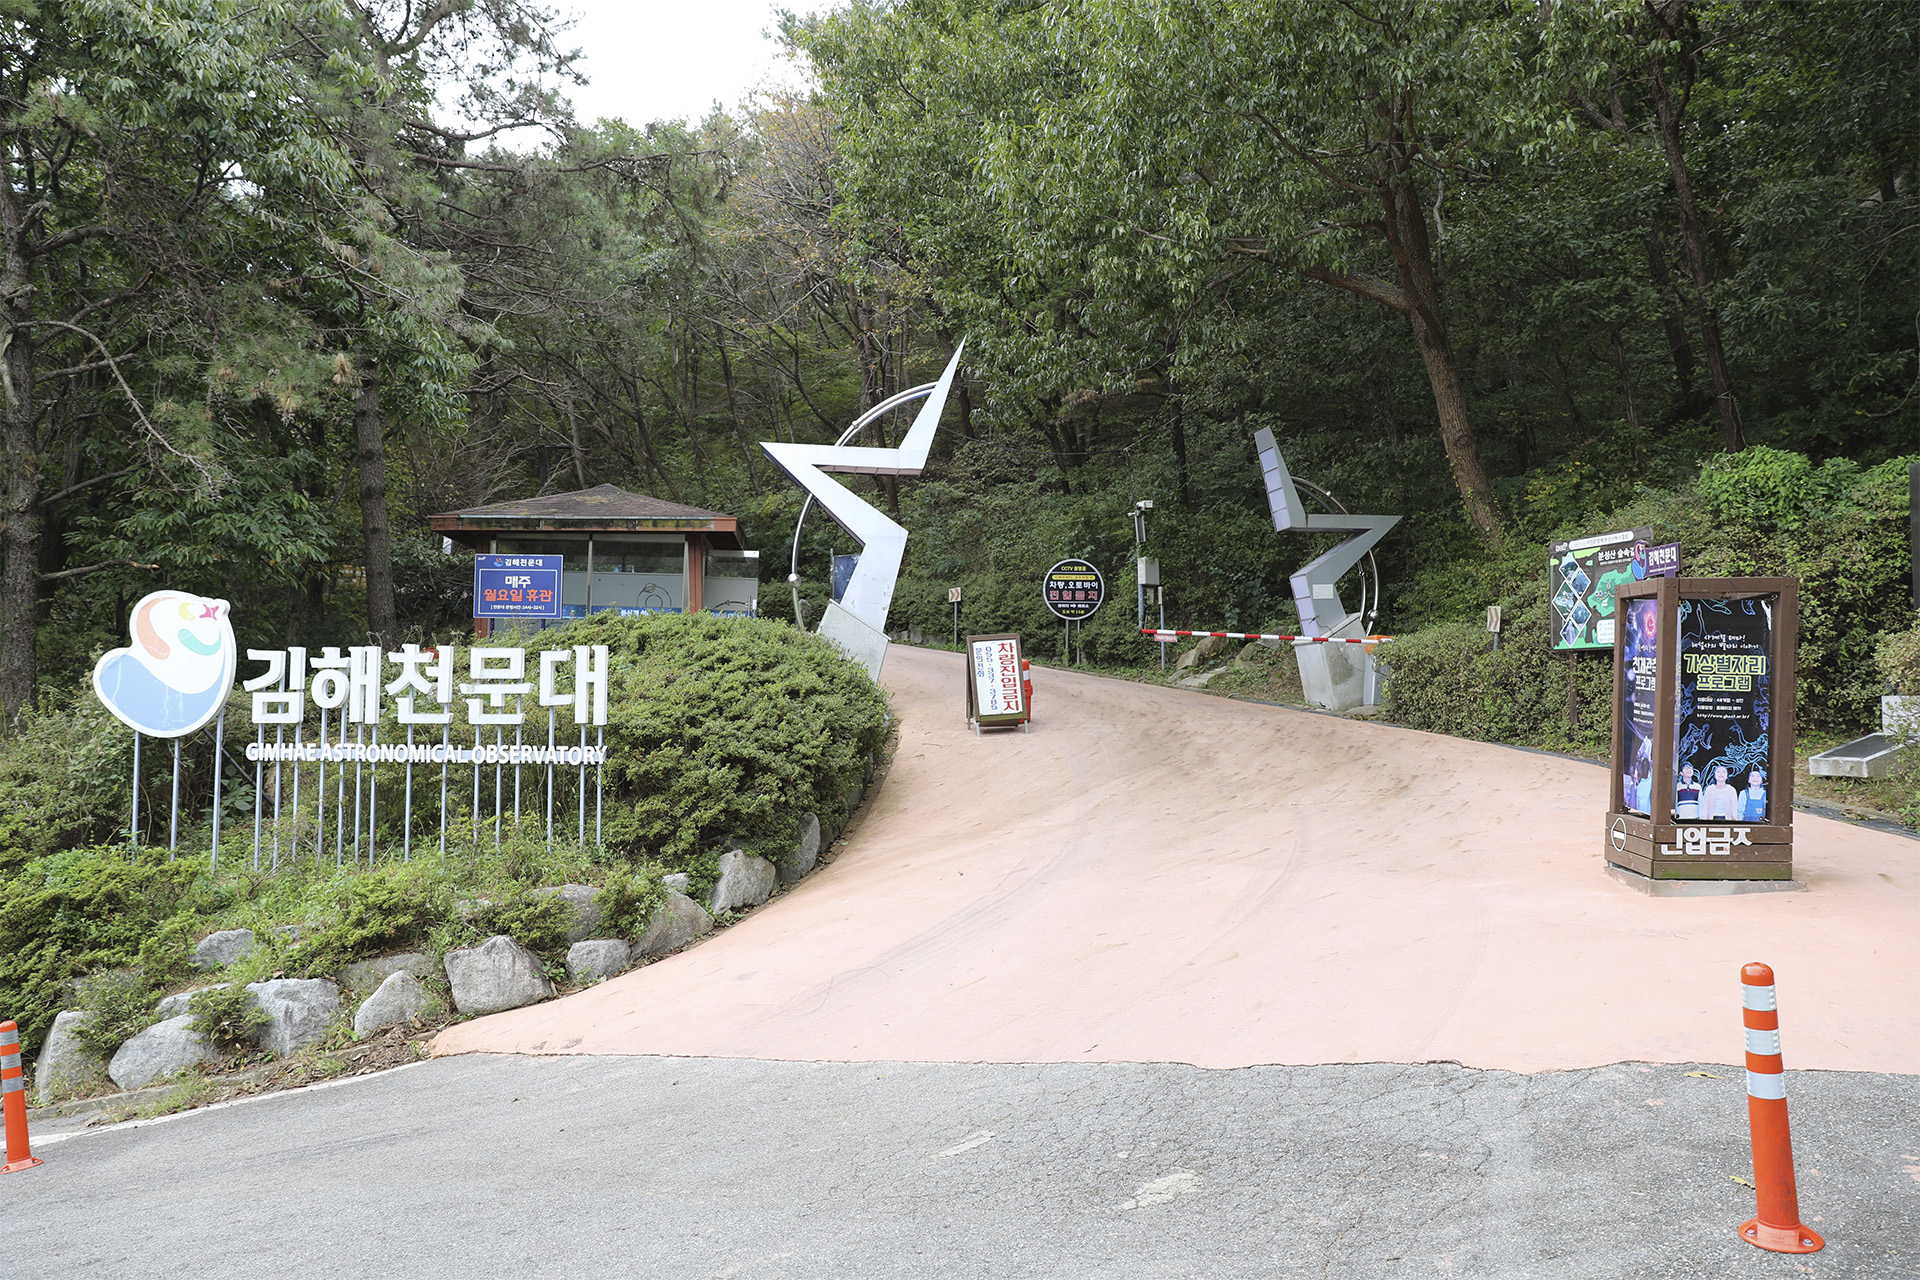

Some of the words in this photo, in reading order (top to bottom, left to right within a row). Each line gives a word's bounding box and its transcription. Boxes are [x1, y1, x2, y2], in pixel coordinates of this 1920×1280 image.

[505, 558, 543, 567] 김해천문대
[1598, 550, 1616, 561] 분성산
[1648, 547, 1677, 566] 김해천문대
[505, 575, 531, 589] 매주
[1049, 581, 1098, 590] 차량,오토바이
[484, 588, 523, 602] 월요일
[526, 589, 553, 603] 휴관
[975, 647, 985, 677] 문의전화
[1683, 654, 1766, 675] 가상별자리
[242, 643, 609, 726] 김해천문대
[998, 642, 1020, 711] 차량진입금지
[1696, 674, 1751, 692] 프로그램
[245, 742, 317, 762] GIMHAE
[321, 743, 470, 765] ASTRONOMICAL
[471, 744, 609, 767] OBSERVATORY
